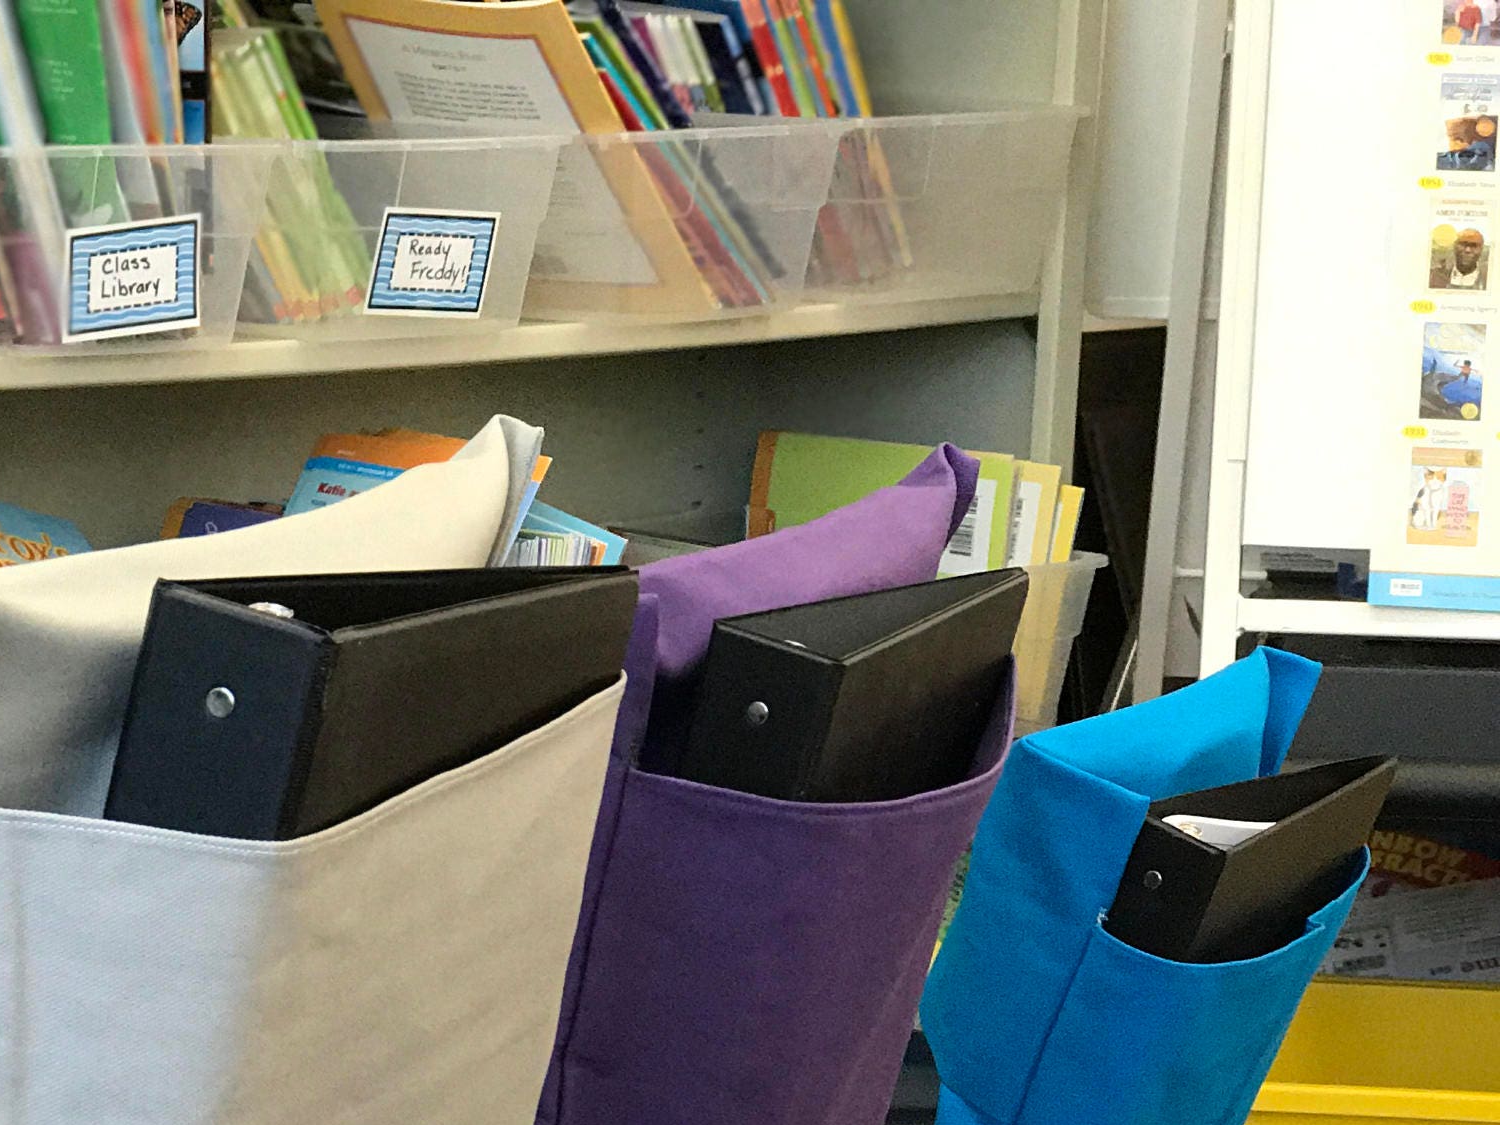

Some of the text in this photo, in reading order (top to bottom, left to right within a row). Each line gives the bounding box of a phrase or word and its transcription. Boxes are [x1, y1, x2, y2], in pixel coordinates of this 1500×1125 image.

[409, 239, 452, 262] Ready
[102, 256, 151, 275] Class
[410, 261, 468, 286] Freddy!
[101, 277, 160, 299] Library
